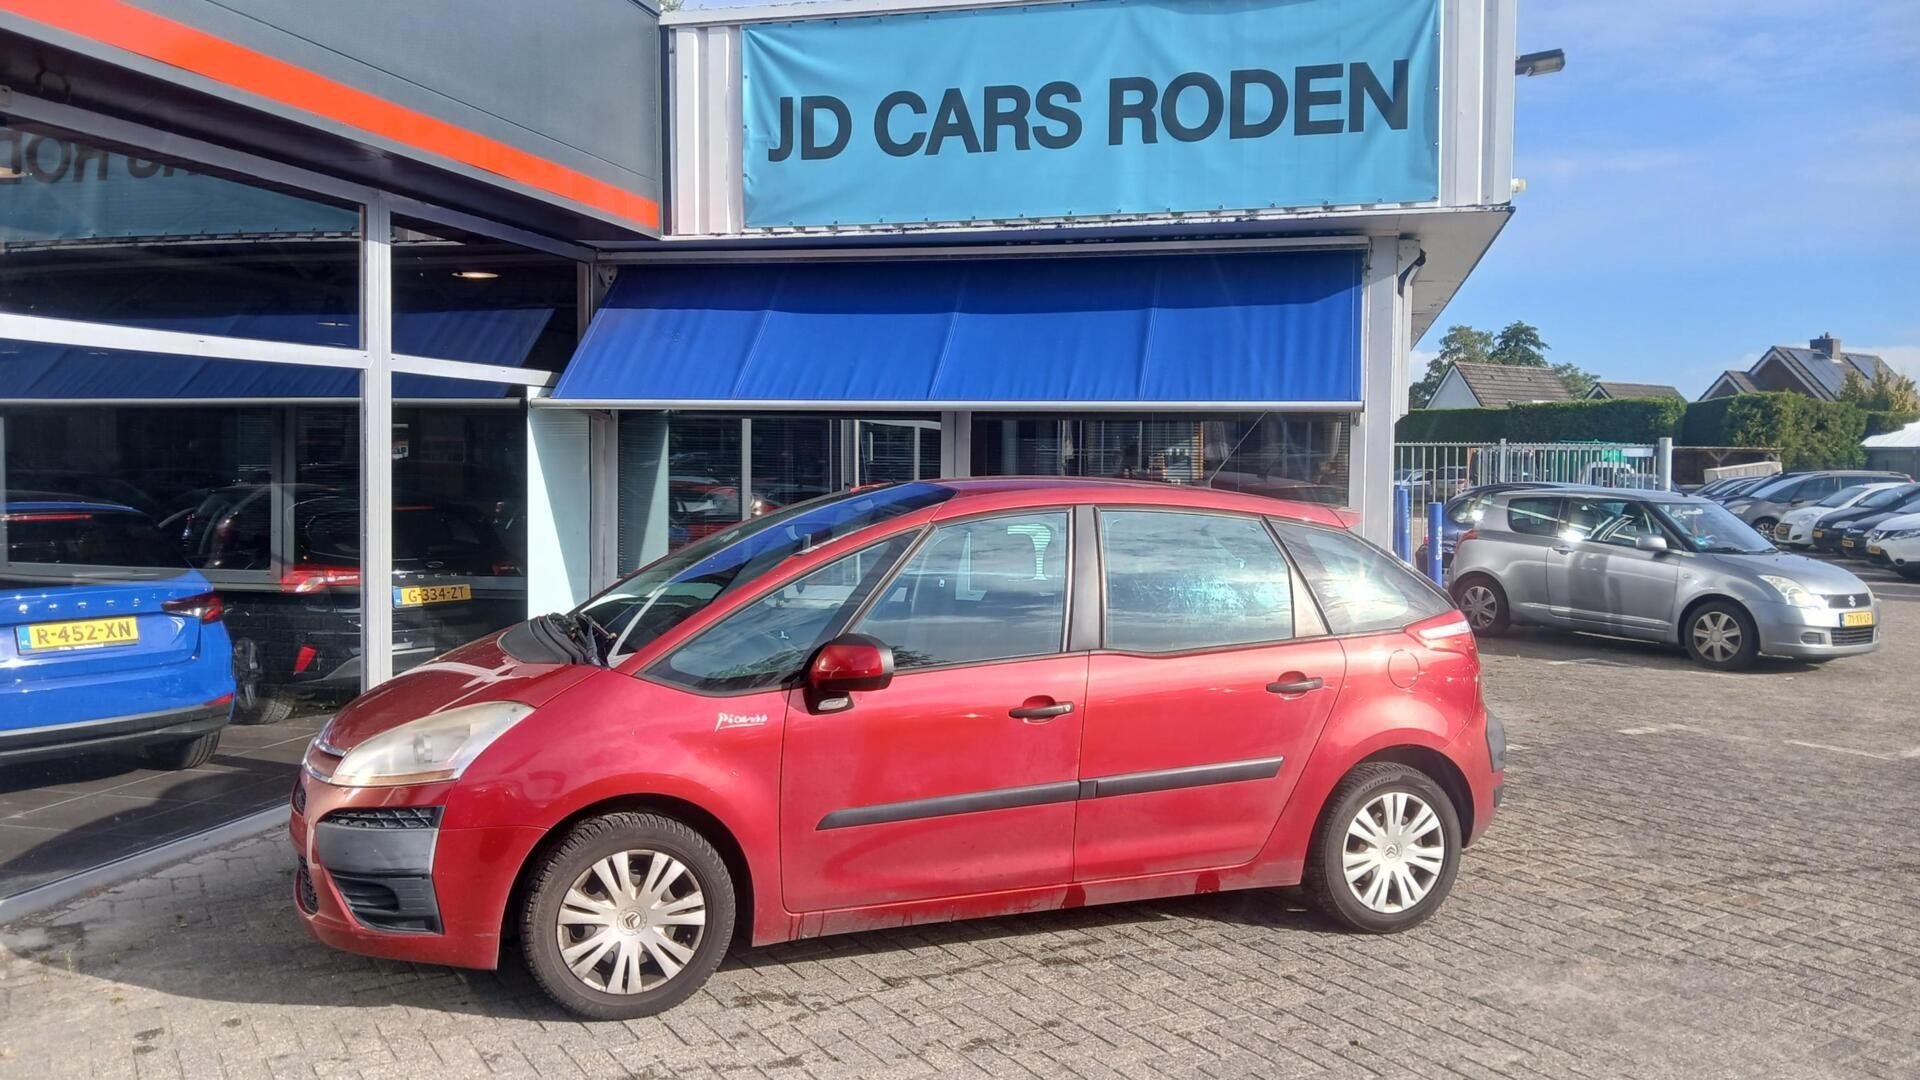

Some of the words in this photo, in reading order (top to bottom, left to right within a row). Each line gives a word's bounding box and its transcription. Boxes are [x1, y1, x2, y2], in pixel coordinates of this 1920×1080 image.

[768, 95, 852, 162] JD
[873, 81, 1083, 157] CARS
[1108, 59, 1409, 147] RODEN
[408, 586, 465, 603] G-334-ZT
[36, 621, 132, 645] R-452-XN
